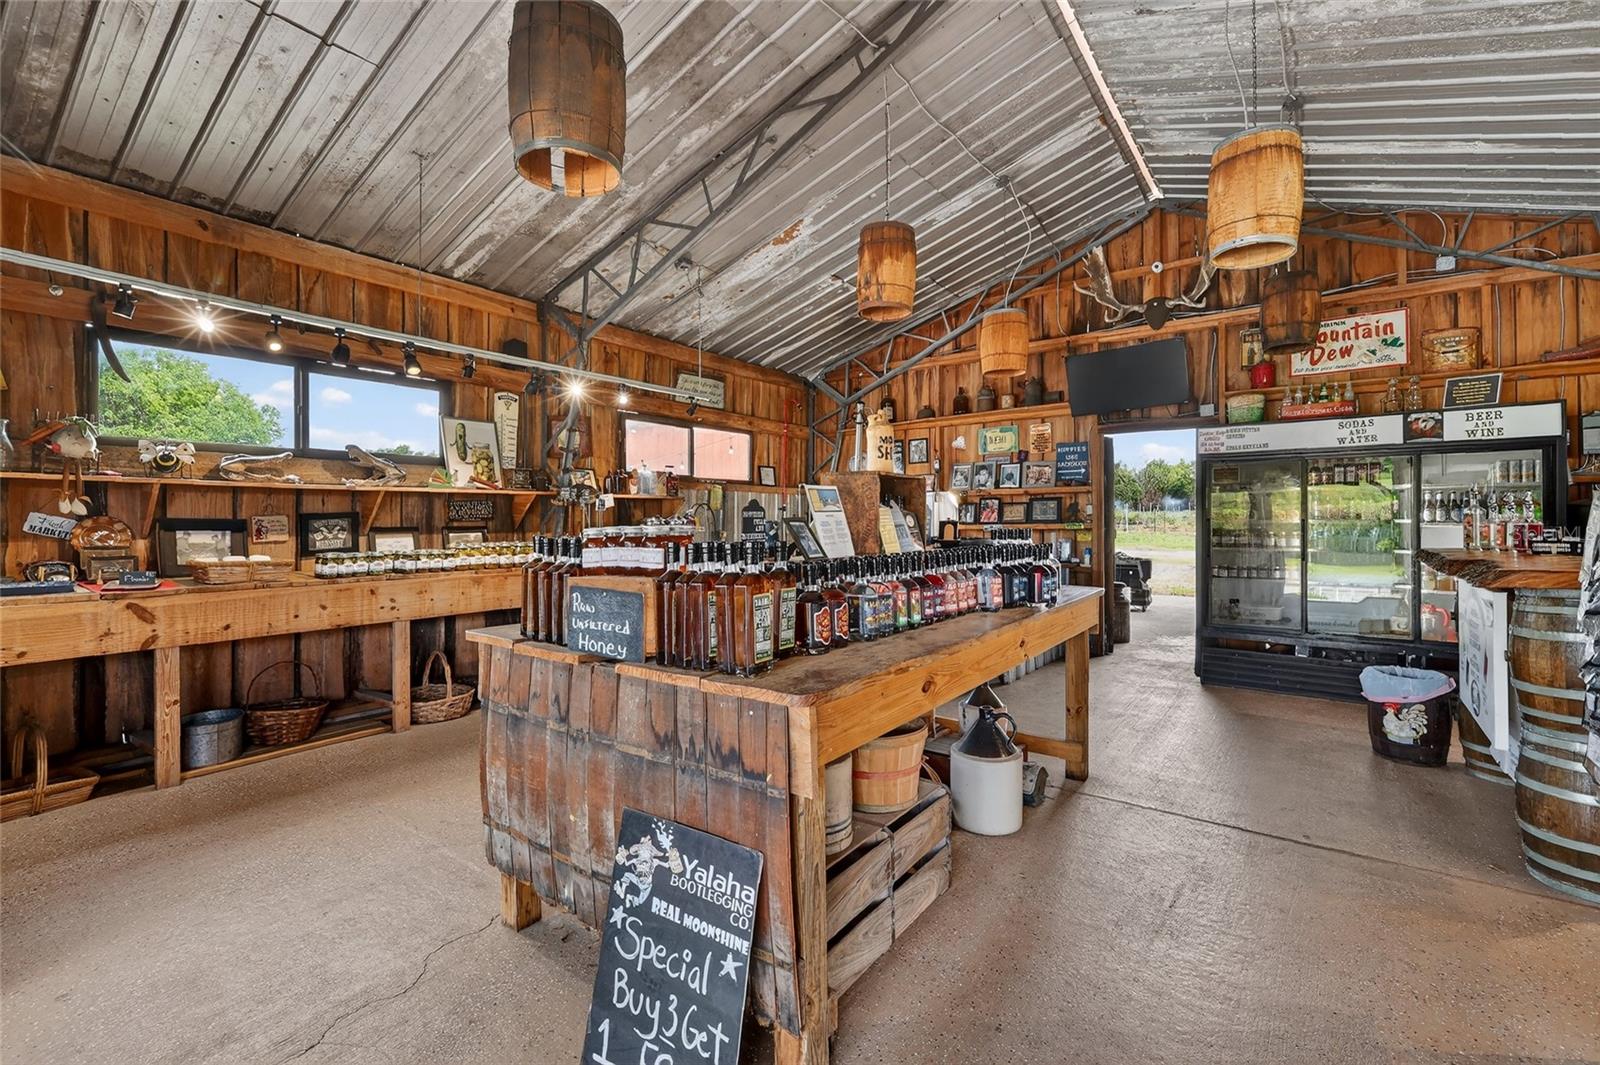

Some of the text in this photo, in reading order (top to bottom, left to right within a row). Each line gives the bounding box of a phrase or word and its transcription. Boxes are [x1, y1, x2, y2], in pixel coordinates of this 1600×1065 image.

[1317, 320, 1394, 344] ountain
[1303, 344, 1354, 366] Dew
[1337, 419, 1375, 430] SODAS
[1465, 410, 1504, 422] BEER
[1336, 434, 1379, 446] WATER
[1349, 428, 1367, 436] AND
[1465, 427, 1505, 438] WINE
[27, 524, 70, 539] MARKET
[578, 632, 627, 659] Honey
[682, 854, 756, 905] Yalaha
[669, 873, 754, 918] BOOTLEGGING
[650, 896, 750, 956] REAL MOONSHINE
[614, 917, 713, 996] Special
[612, 967, 661, 1041] Buy
[660, 994, 679, 1038] 3
[681, 1004, 730, 1065] Get
